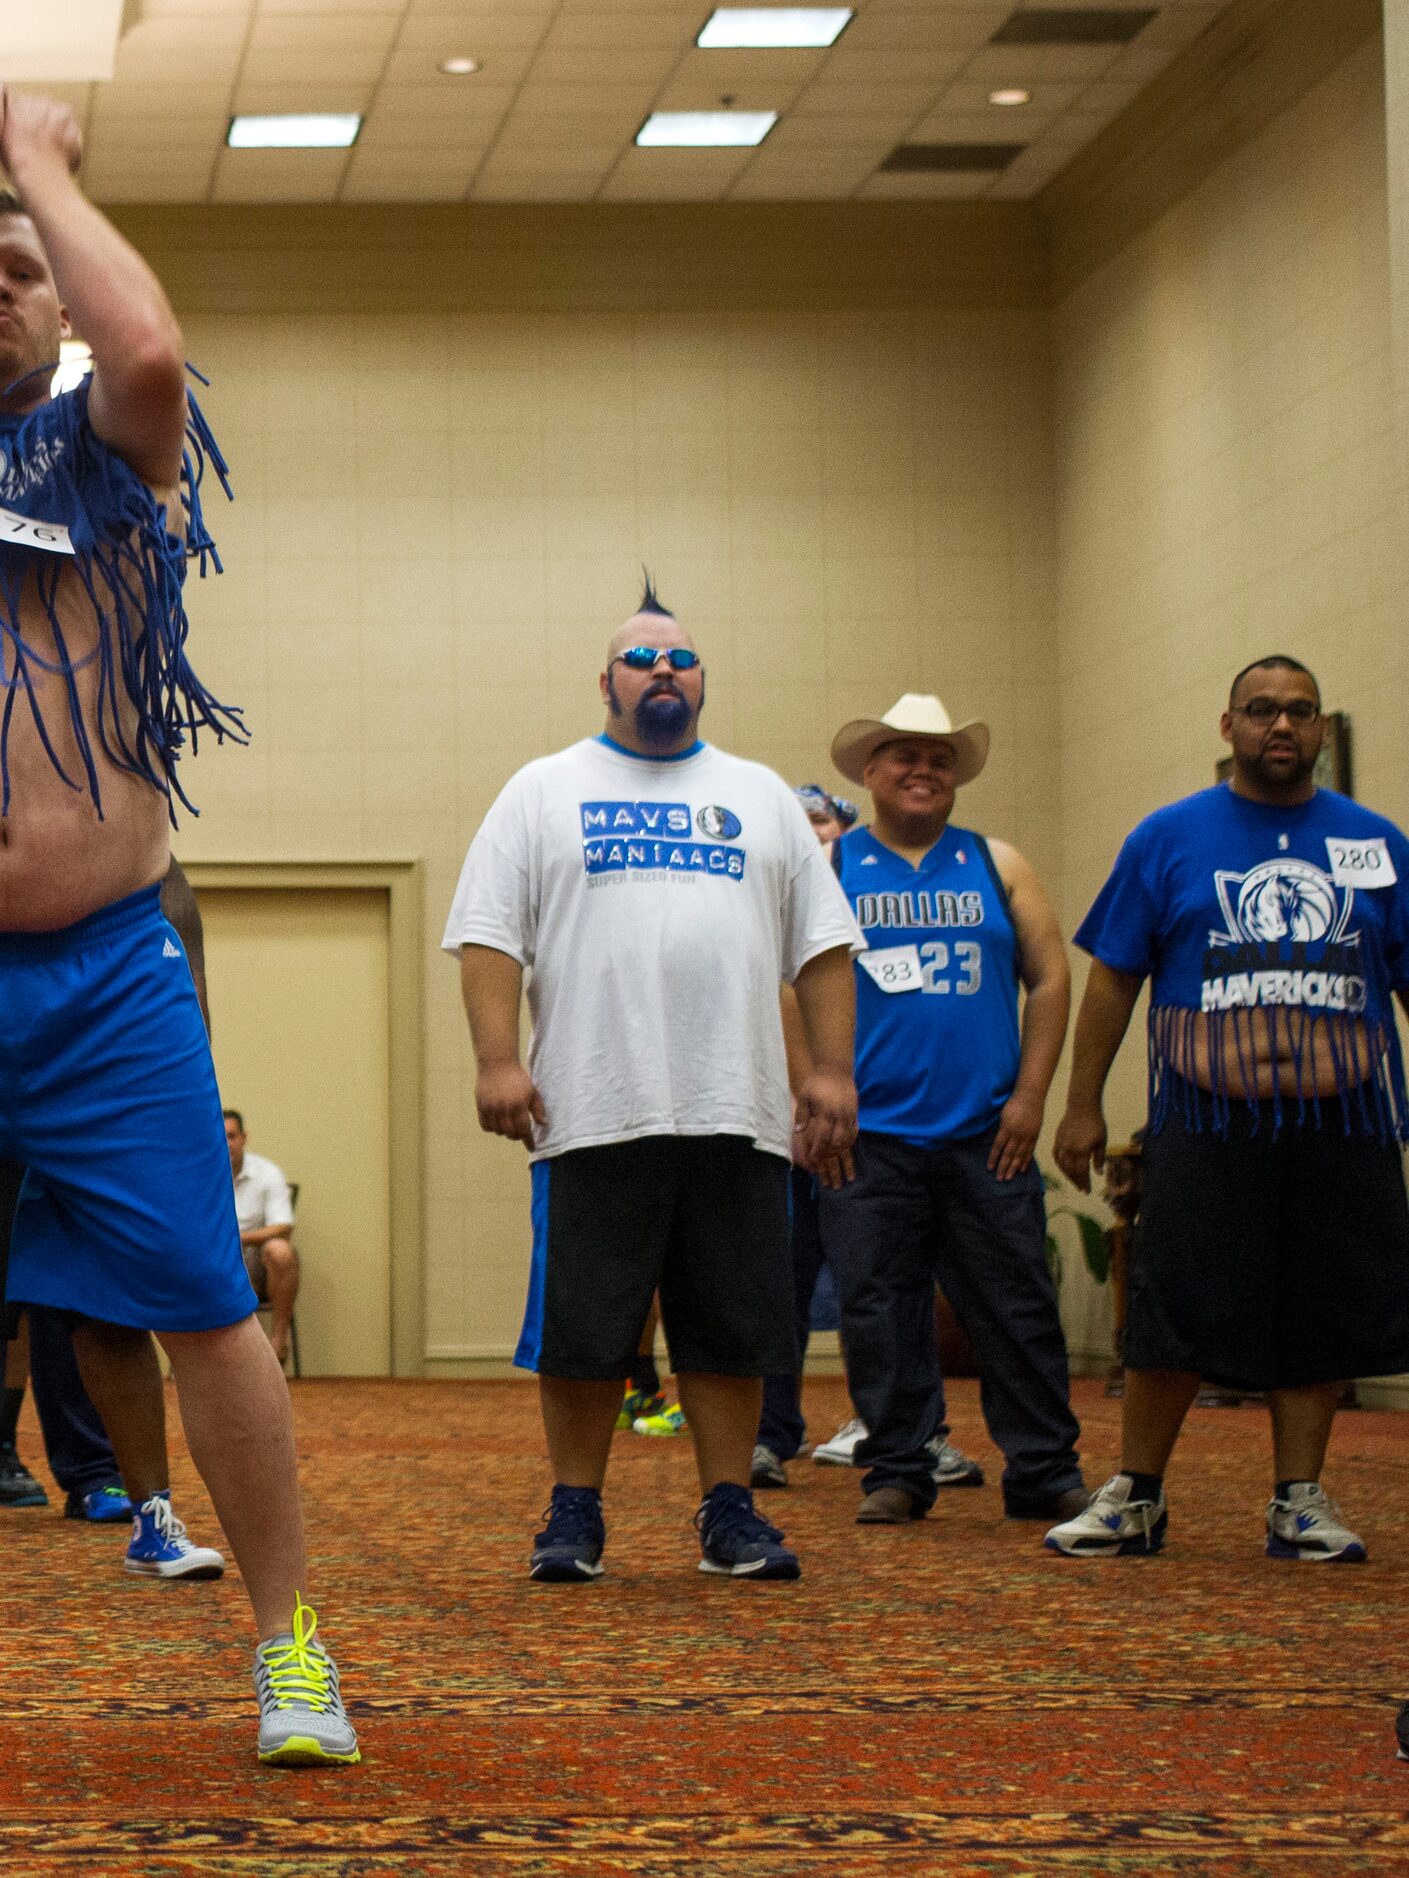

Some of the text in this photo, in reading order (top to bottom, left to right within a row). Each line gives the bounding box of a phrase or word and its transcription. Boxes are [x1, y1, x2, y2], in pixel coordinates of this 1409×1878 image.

[583, 807, 689, 831] MAVS
[586, 843, 743, 874] MANIAACS
[1334, 846, 1382, 870] 280
[586, 871, 696, 889] SUPER SIZED FUN
[857, 890, 984, 928] DALLAS
[871, 959, 912, 984] 83
[920, 940, 983, 996] 23
